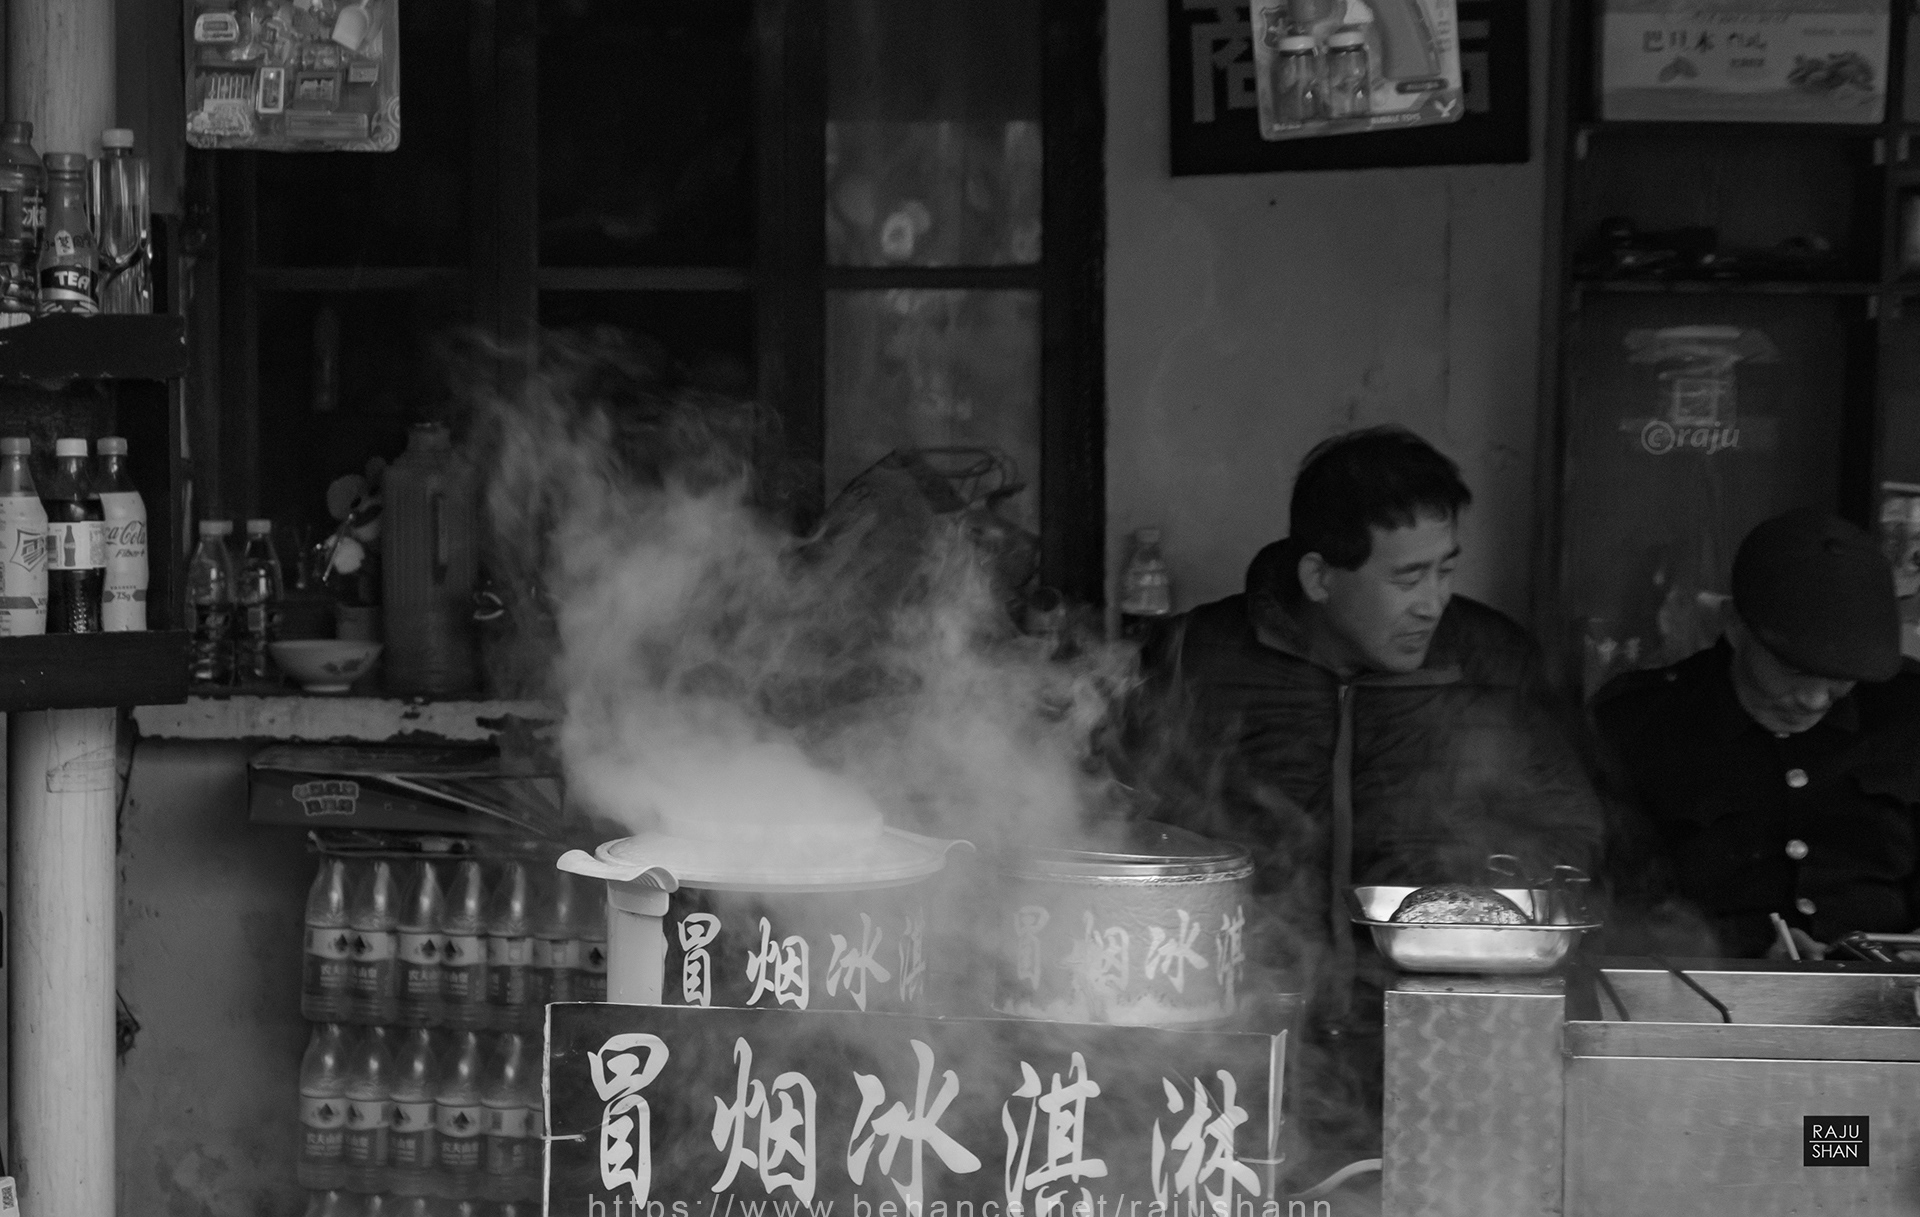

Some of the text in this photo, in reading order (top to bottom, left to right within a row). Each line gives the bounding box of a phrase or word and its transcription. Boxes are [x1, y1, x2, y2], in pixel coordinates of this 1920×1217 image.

[54, 270, 91, 290] TEA
[587, 1033, 1261, 1217] 冒烟冰淇淋
